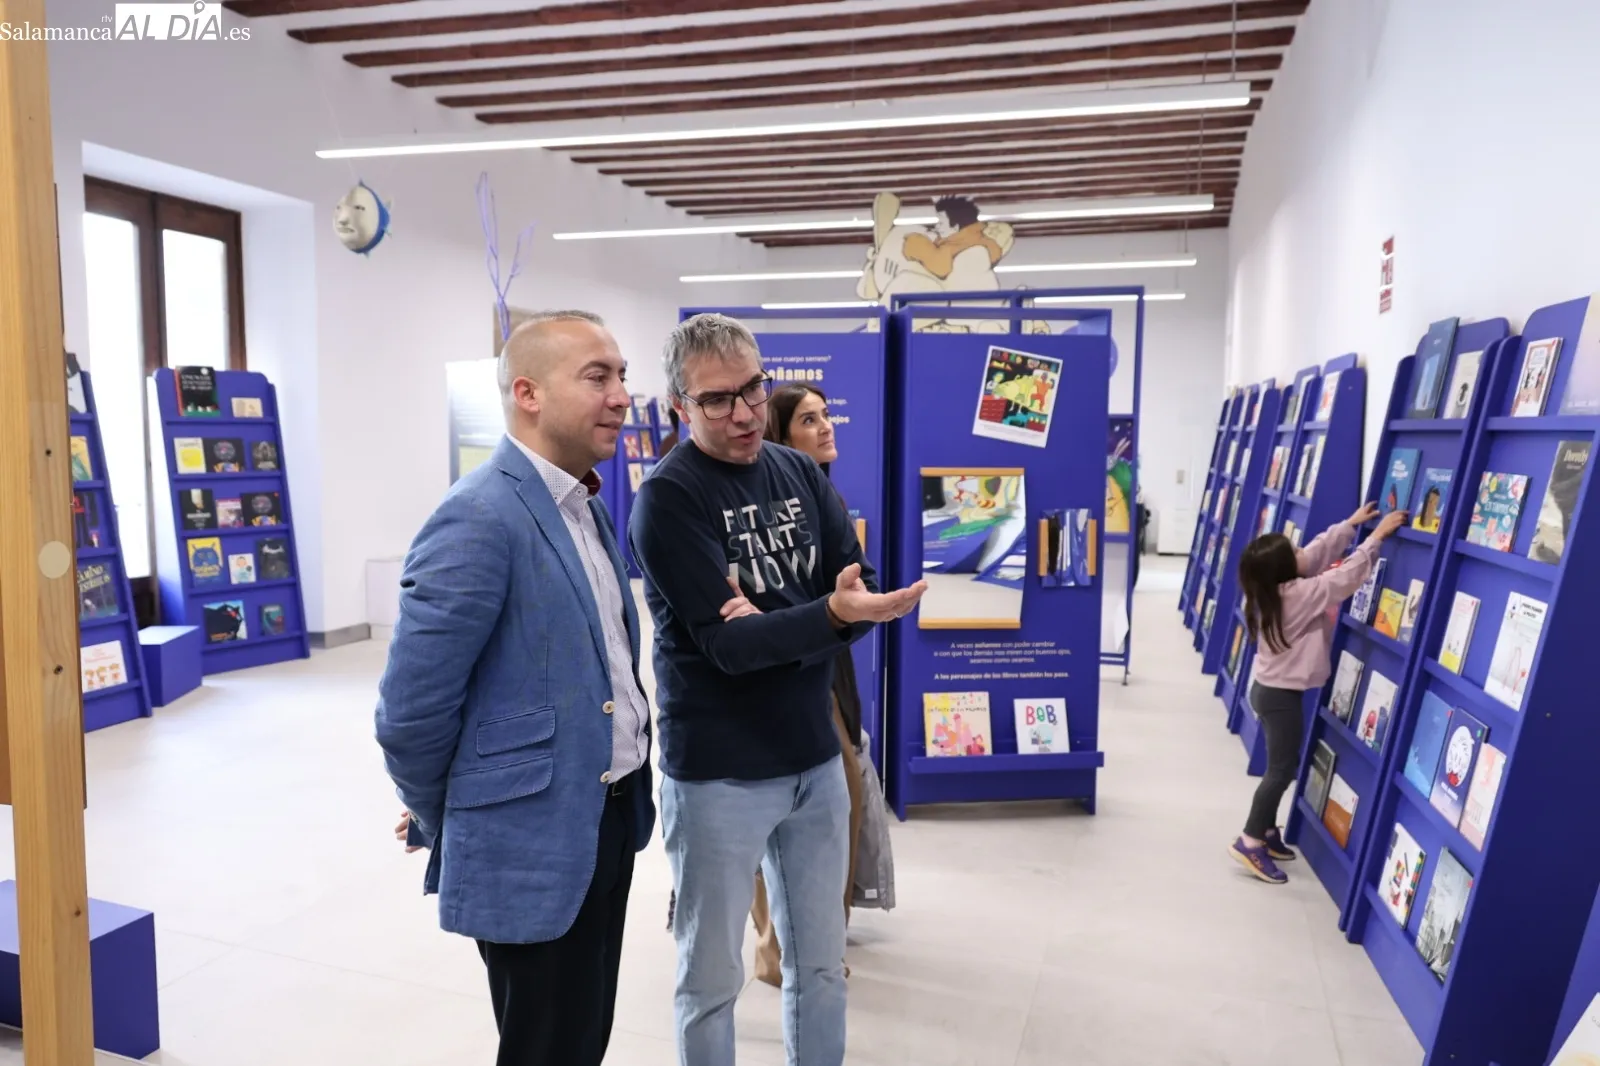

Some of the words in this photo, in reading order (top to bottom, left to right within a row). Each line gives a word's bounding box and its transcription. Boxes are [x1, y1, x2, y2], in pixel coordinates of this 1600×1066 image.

[763, 366, 824, 381] oñamos
[722, 497, 807, 533] FUTURE
[727, 520, 813, 561] STARTS
[728, 544, 817, 594] NOW
[1025, 704, 1056, 725] BOB
